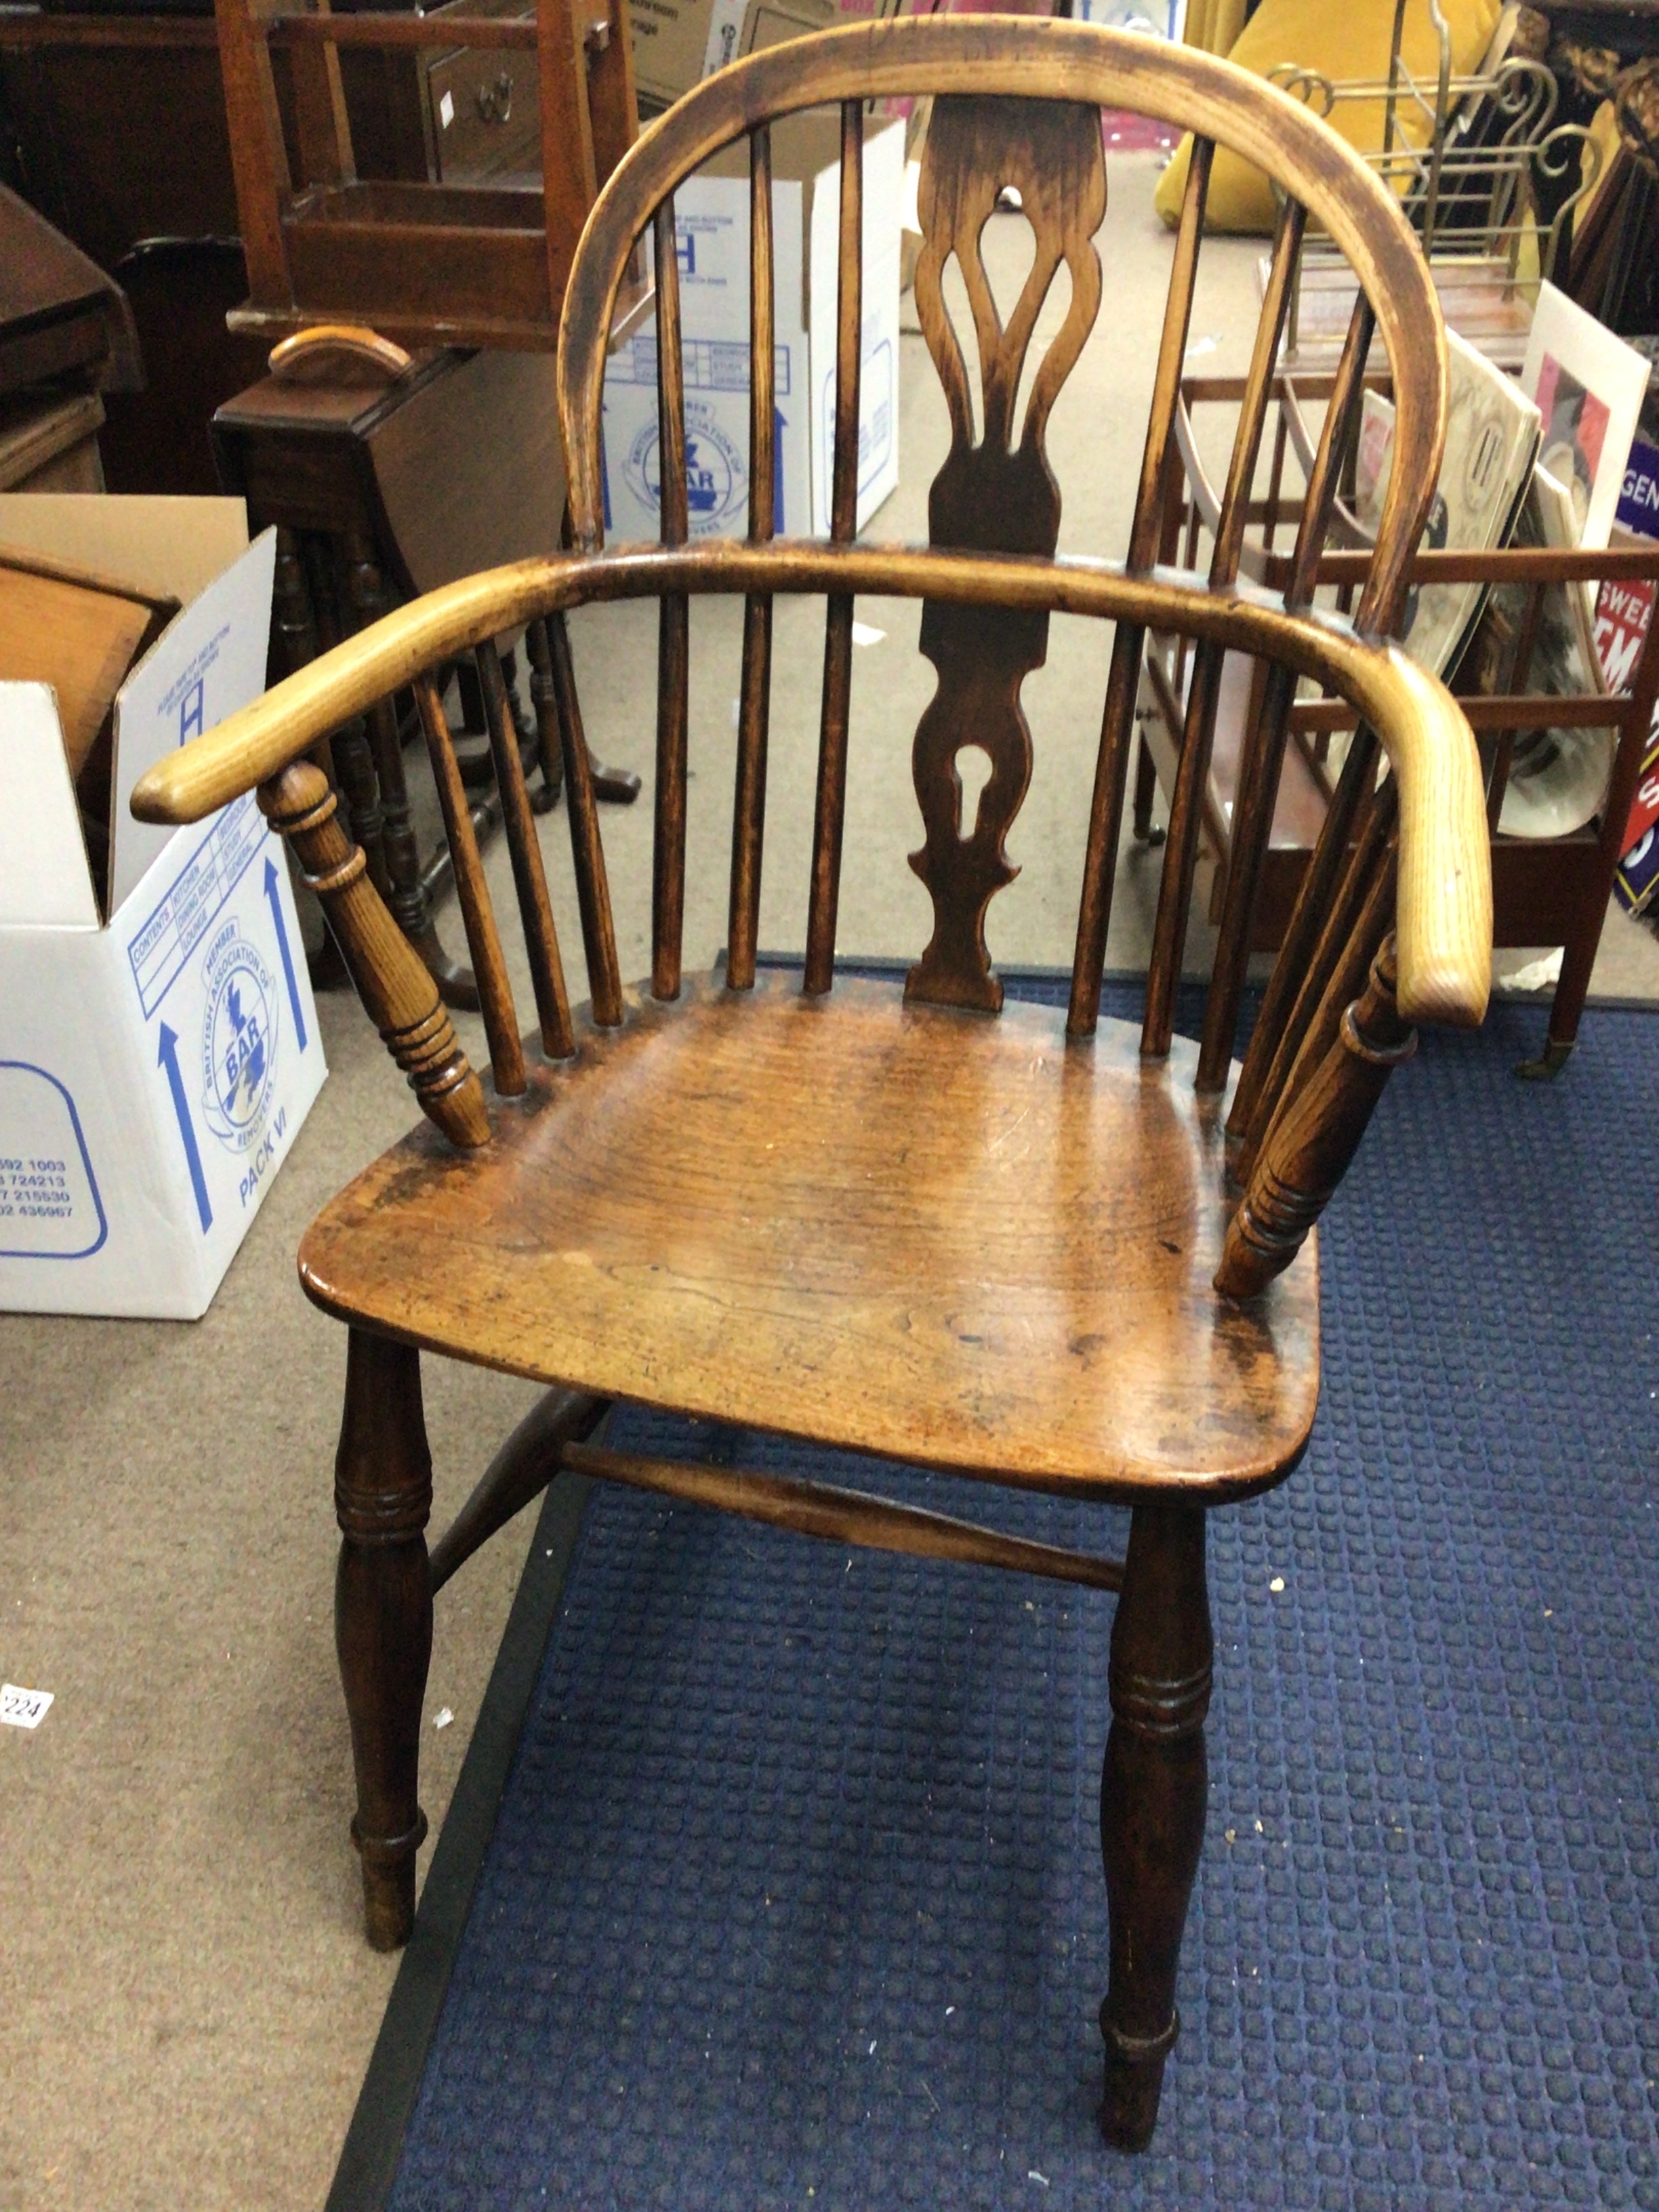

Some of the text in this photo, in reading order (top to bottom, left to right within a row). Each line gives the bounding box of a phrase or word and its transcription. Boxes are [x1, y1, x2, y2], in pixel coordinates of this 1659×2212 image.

[686, 470, 714, 489] AR
[134, 906, 170, 963] CONTENTS
[173, 864, 200, 907] KITCHEN
[182, 907, 207, 951] LOUNGE
[206, 923, 237, 975] MEMBER
[211, 946, 260, 1003] ASSOCIATION
[226, 1015, 261, 1086] BAR
[237, 1080, 273, 1148] REMOVERS
[239, 1130, 275, 1208] PACK
